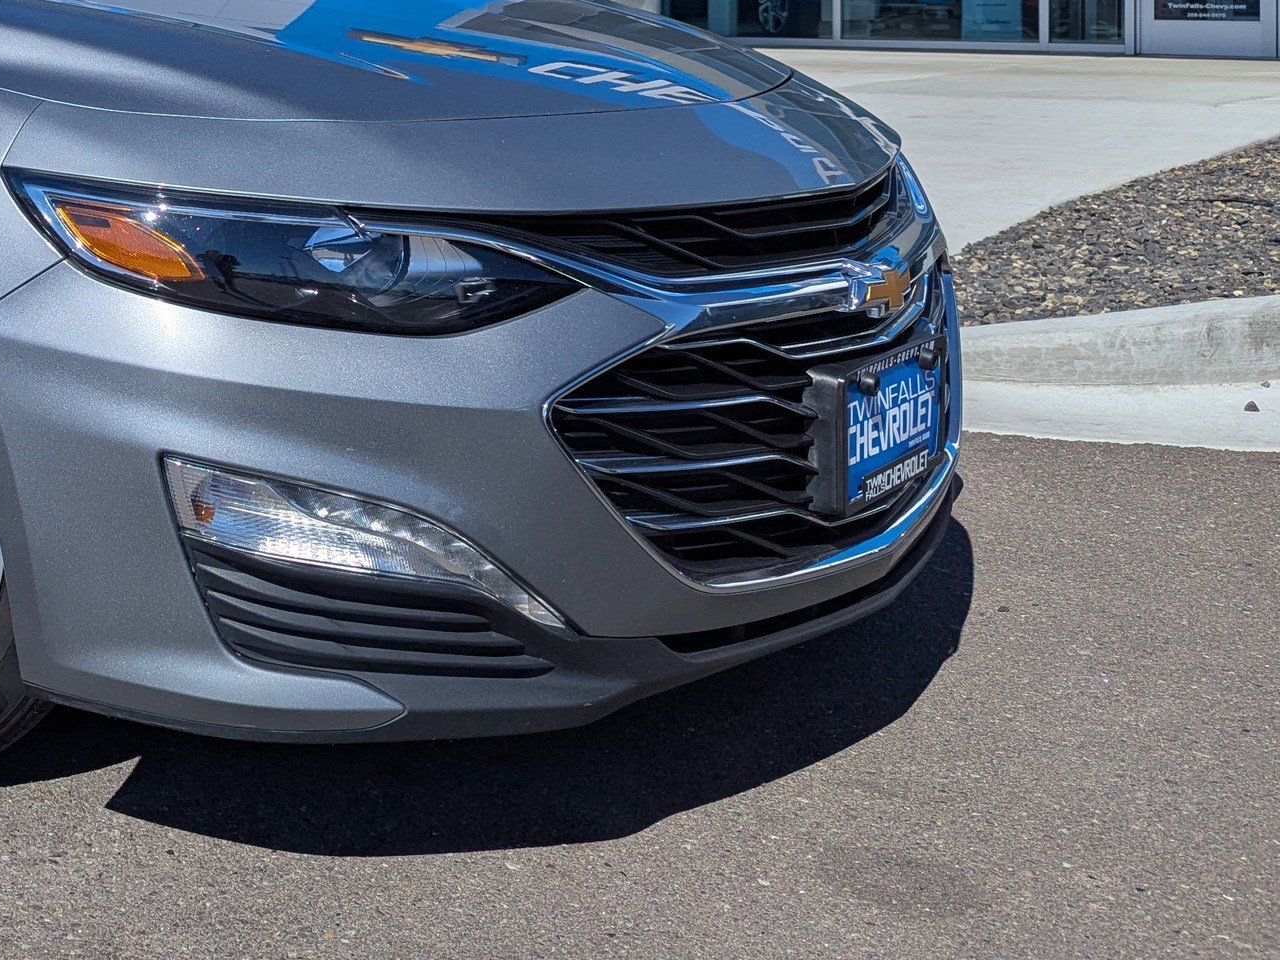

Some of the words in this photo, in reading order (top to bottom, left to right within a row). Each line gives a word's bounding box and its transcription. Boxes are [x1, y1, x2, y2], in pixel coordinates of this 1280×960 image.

[847, 370, 935, 426] TWINFALLS
[847, 390, 935, 466] CHEVROLET
[866, 472, 885, 492] TWIN
[884, 449, 929, 491] CHEVROLET
[865, 483, 885, 502] FALLS
